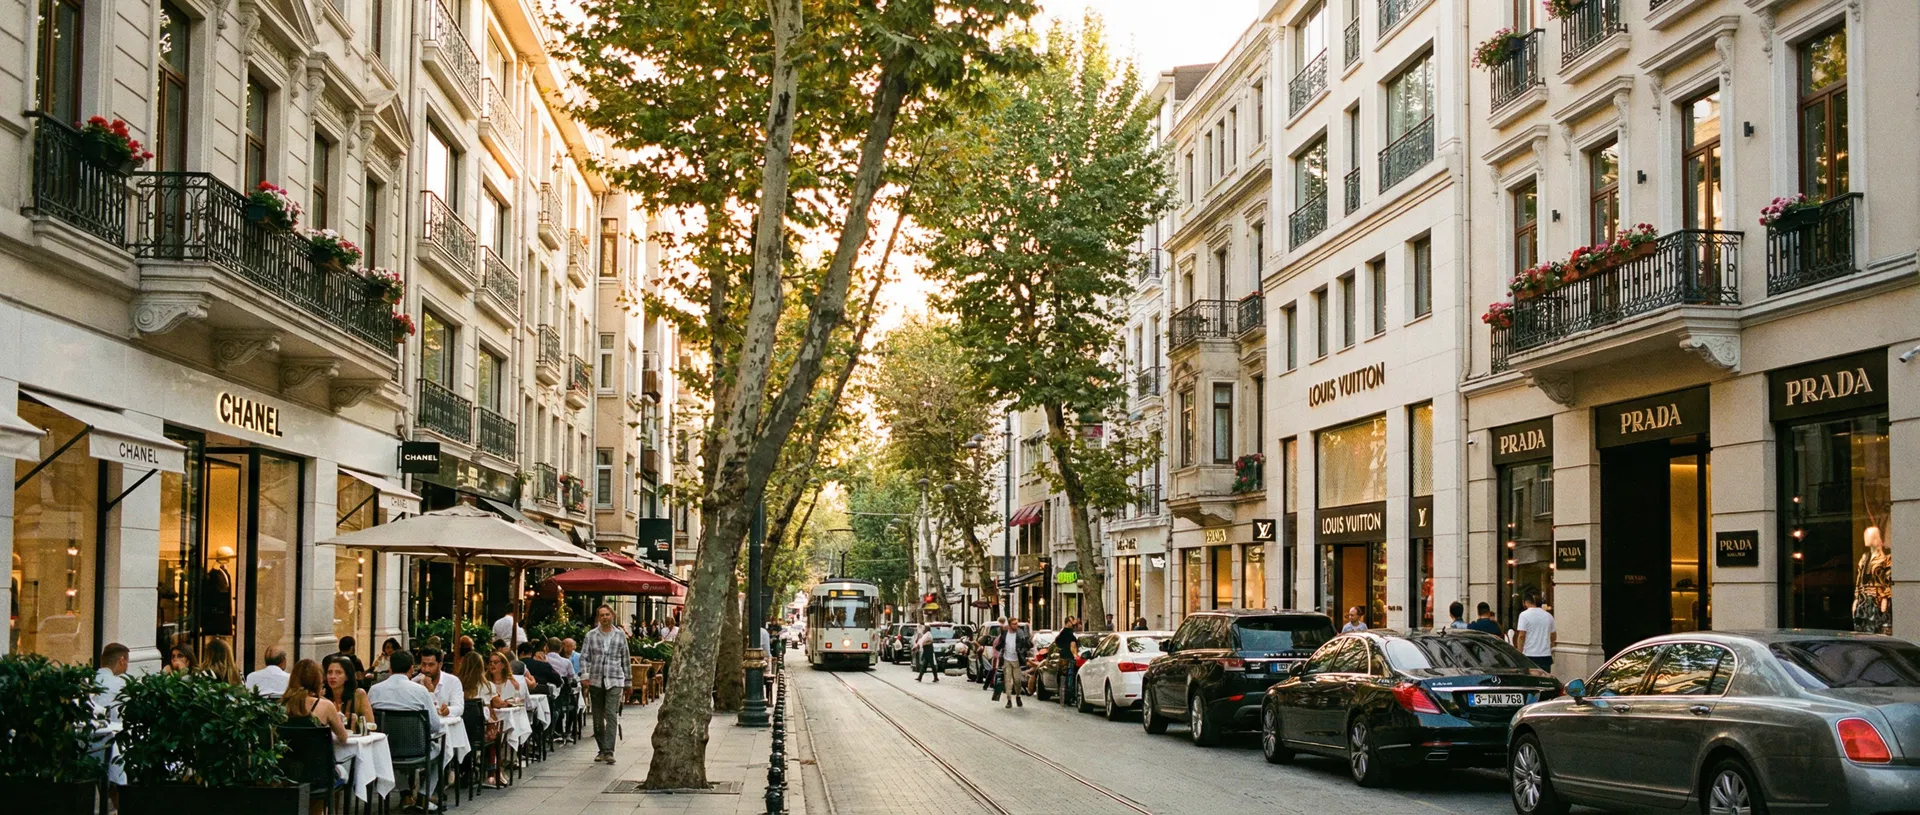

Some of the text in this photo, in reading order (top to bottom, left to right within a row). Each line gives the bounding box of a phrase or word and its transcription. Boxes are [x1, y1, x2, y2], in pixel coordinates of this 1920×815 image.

[1309, 362, 1385, 407] LOUIS VUITTON
[1785, 367, 1873, 406] PRADA
[218, 391, 283, 438] CHANEL
[1620, 403, 1682, 435] PRADA
[119, 442, 159, 464] CHANEL
[1499, 428, 1547, 455] PRADA
[404, 454, 438, 462] CHANEL
[1322, 512, 1381, 535] LOUIS VUITTON
[1558, 546, 1582, 558] PRADA
[1719, 539, 1753, 551] PRADA
[1505, 694, 1522, 704] 768
